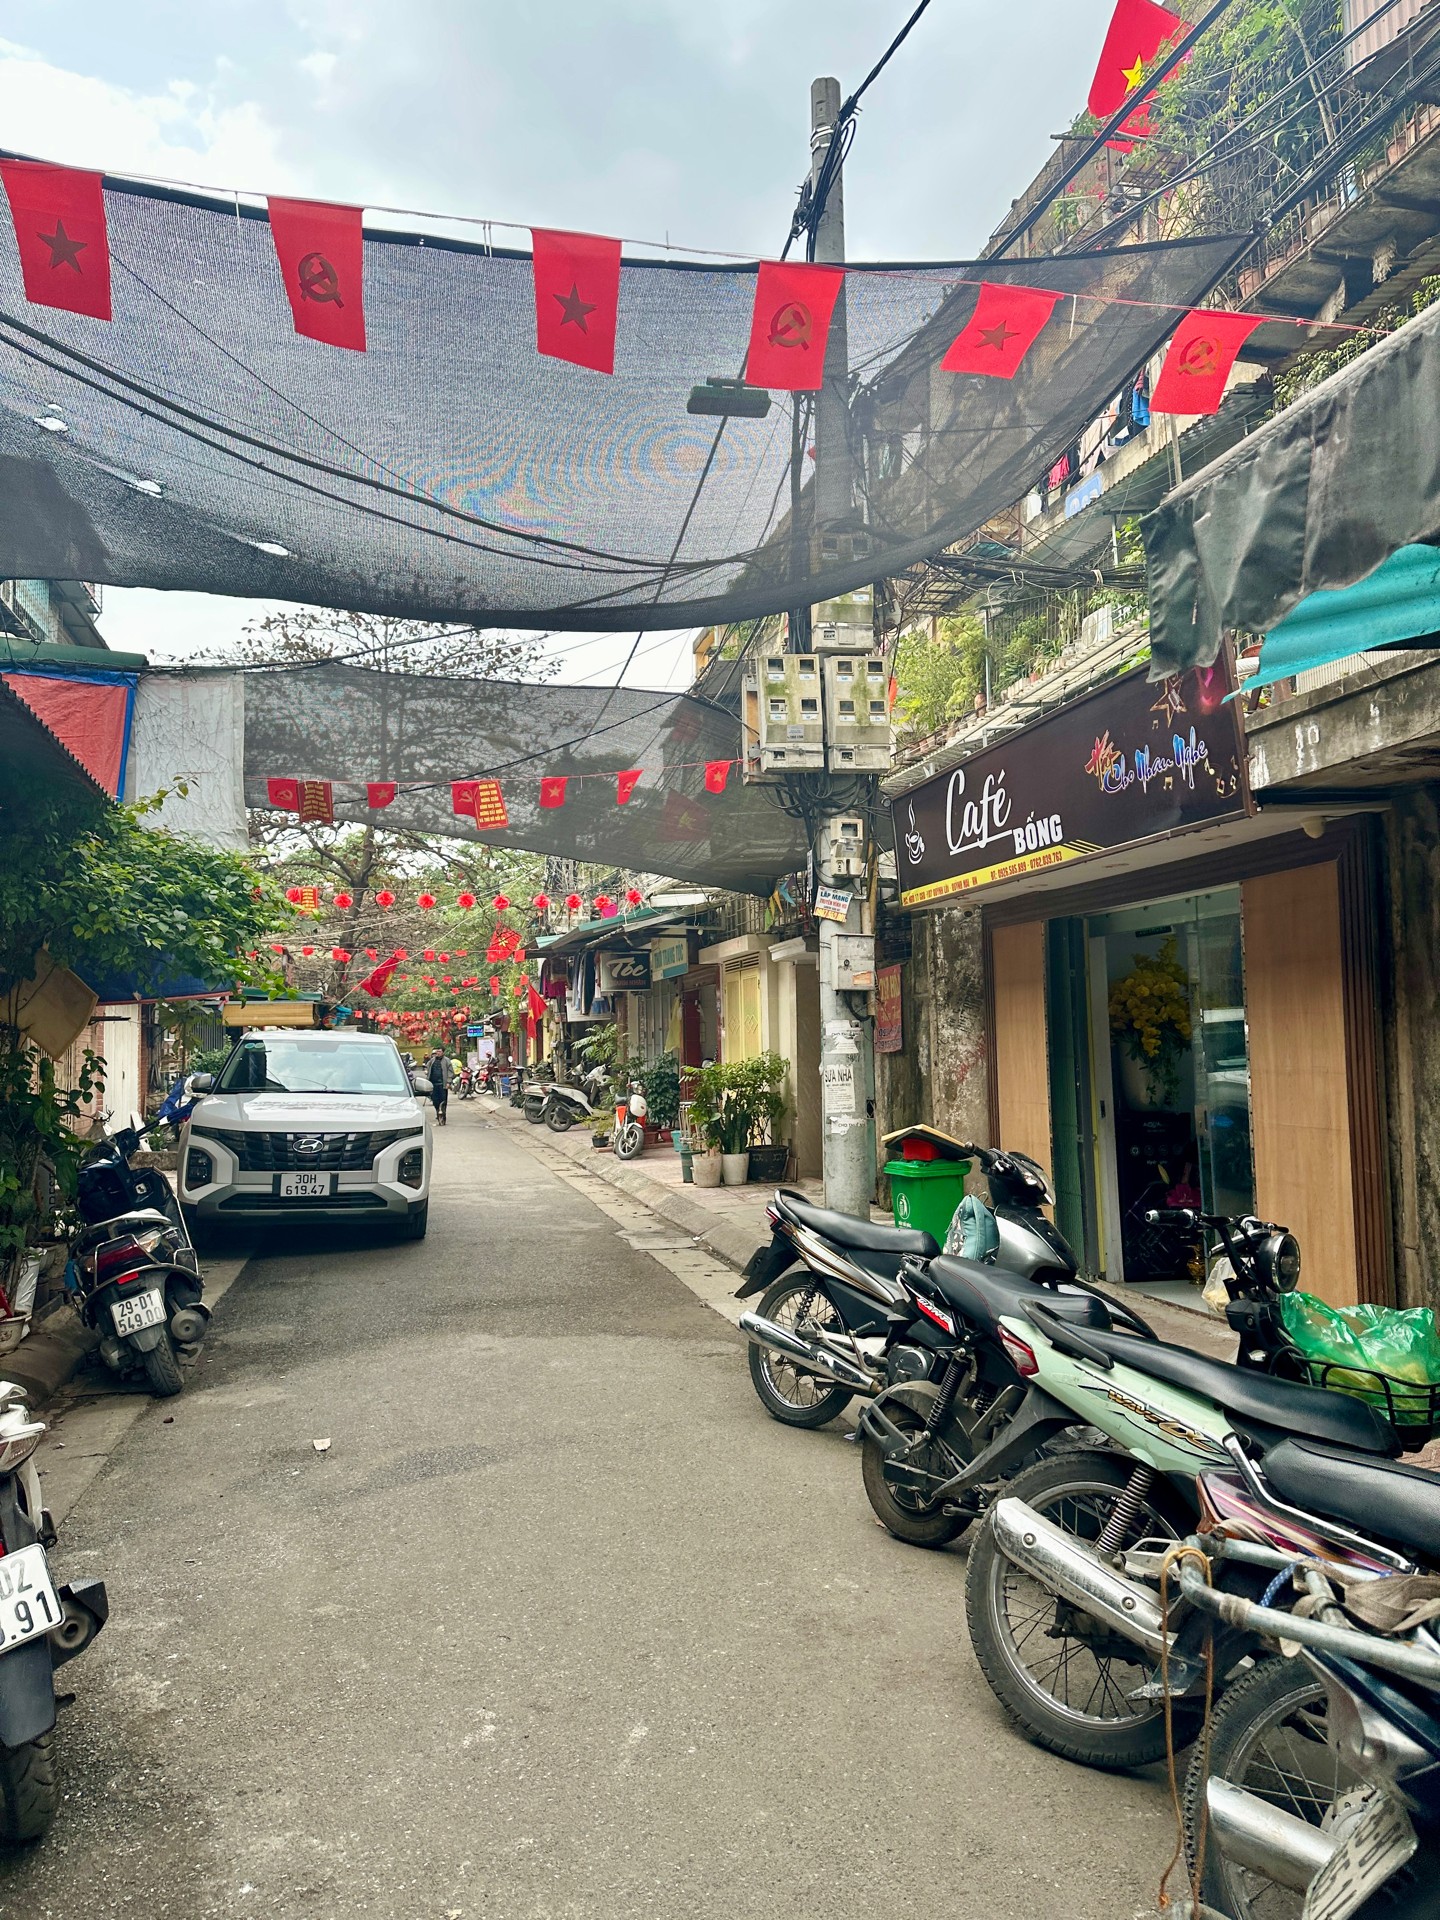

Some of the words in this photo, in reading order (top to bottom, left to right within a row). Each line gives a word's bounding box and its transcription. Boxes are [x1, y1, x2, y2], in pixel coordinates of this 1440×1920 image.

[946, 769, 1011, 851] Café
[1013, 811, 1063, 855] BỐNG
[285, 1184, 325, 1195] 619.47
[295, 1174, 317, 1184] 30H
[118, 1293, 154, 1317] 29-D1
[118, 1307, 163, 1333] 549.00
